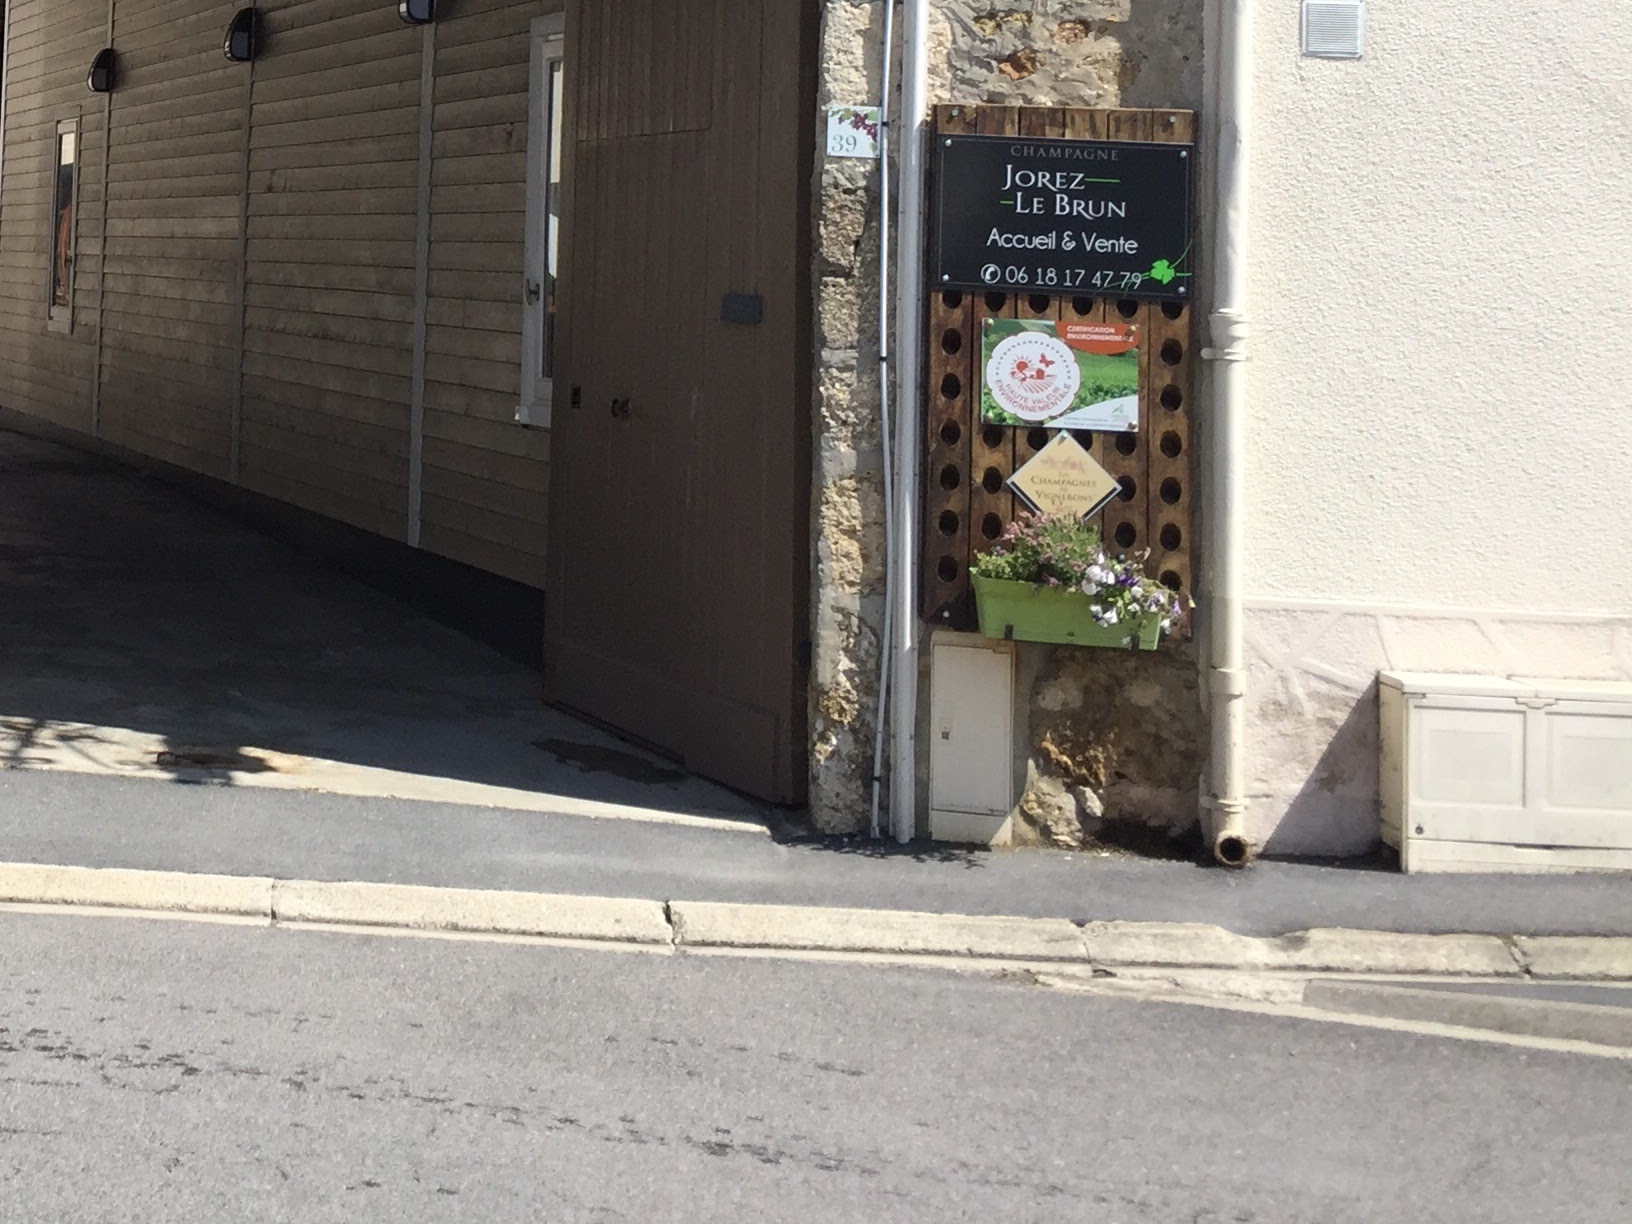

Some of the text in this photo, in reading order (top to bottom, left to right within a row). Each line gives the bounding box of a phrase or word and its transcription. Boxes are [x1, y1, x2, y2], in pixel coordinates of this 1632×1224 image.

[831, 134, 857, 153] 39
[1010, 145, 1120, 161] CHAMPAGNE
[1001, 164, 1086, 192] JOREZ
[1055, 193, 1127, 220] BRUN
[986, 226, 1139, 255] Accueil & Vente
[1005, 265, 1142, 290] 06 18 17 47 79
[995, 379, 1072, 413] ENVIRONNEMENTALE
[1004, 382, 1063, 406] HAUTE VALEUR
[1030, 475, 1097, 488] CHAMPAGNES
[1035, 490, 1093, 502] VIGNERONS
